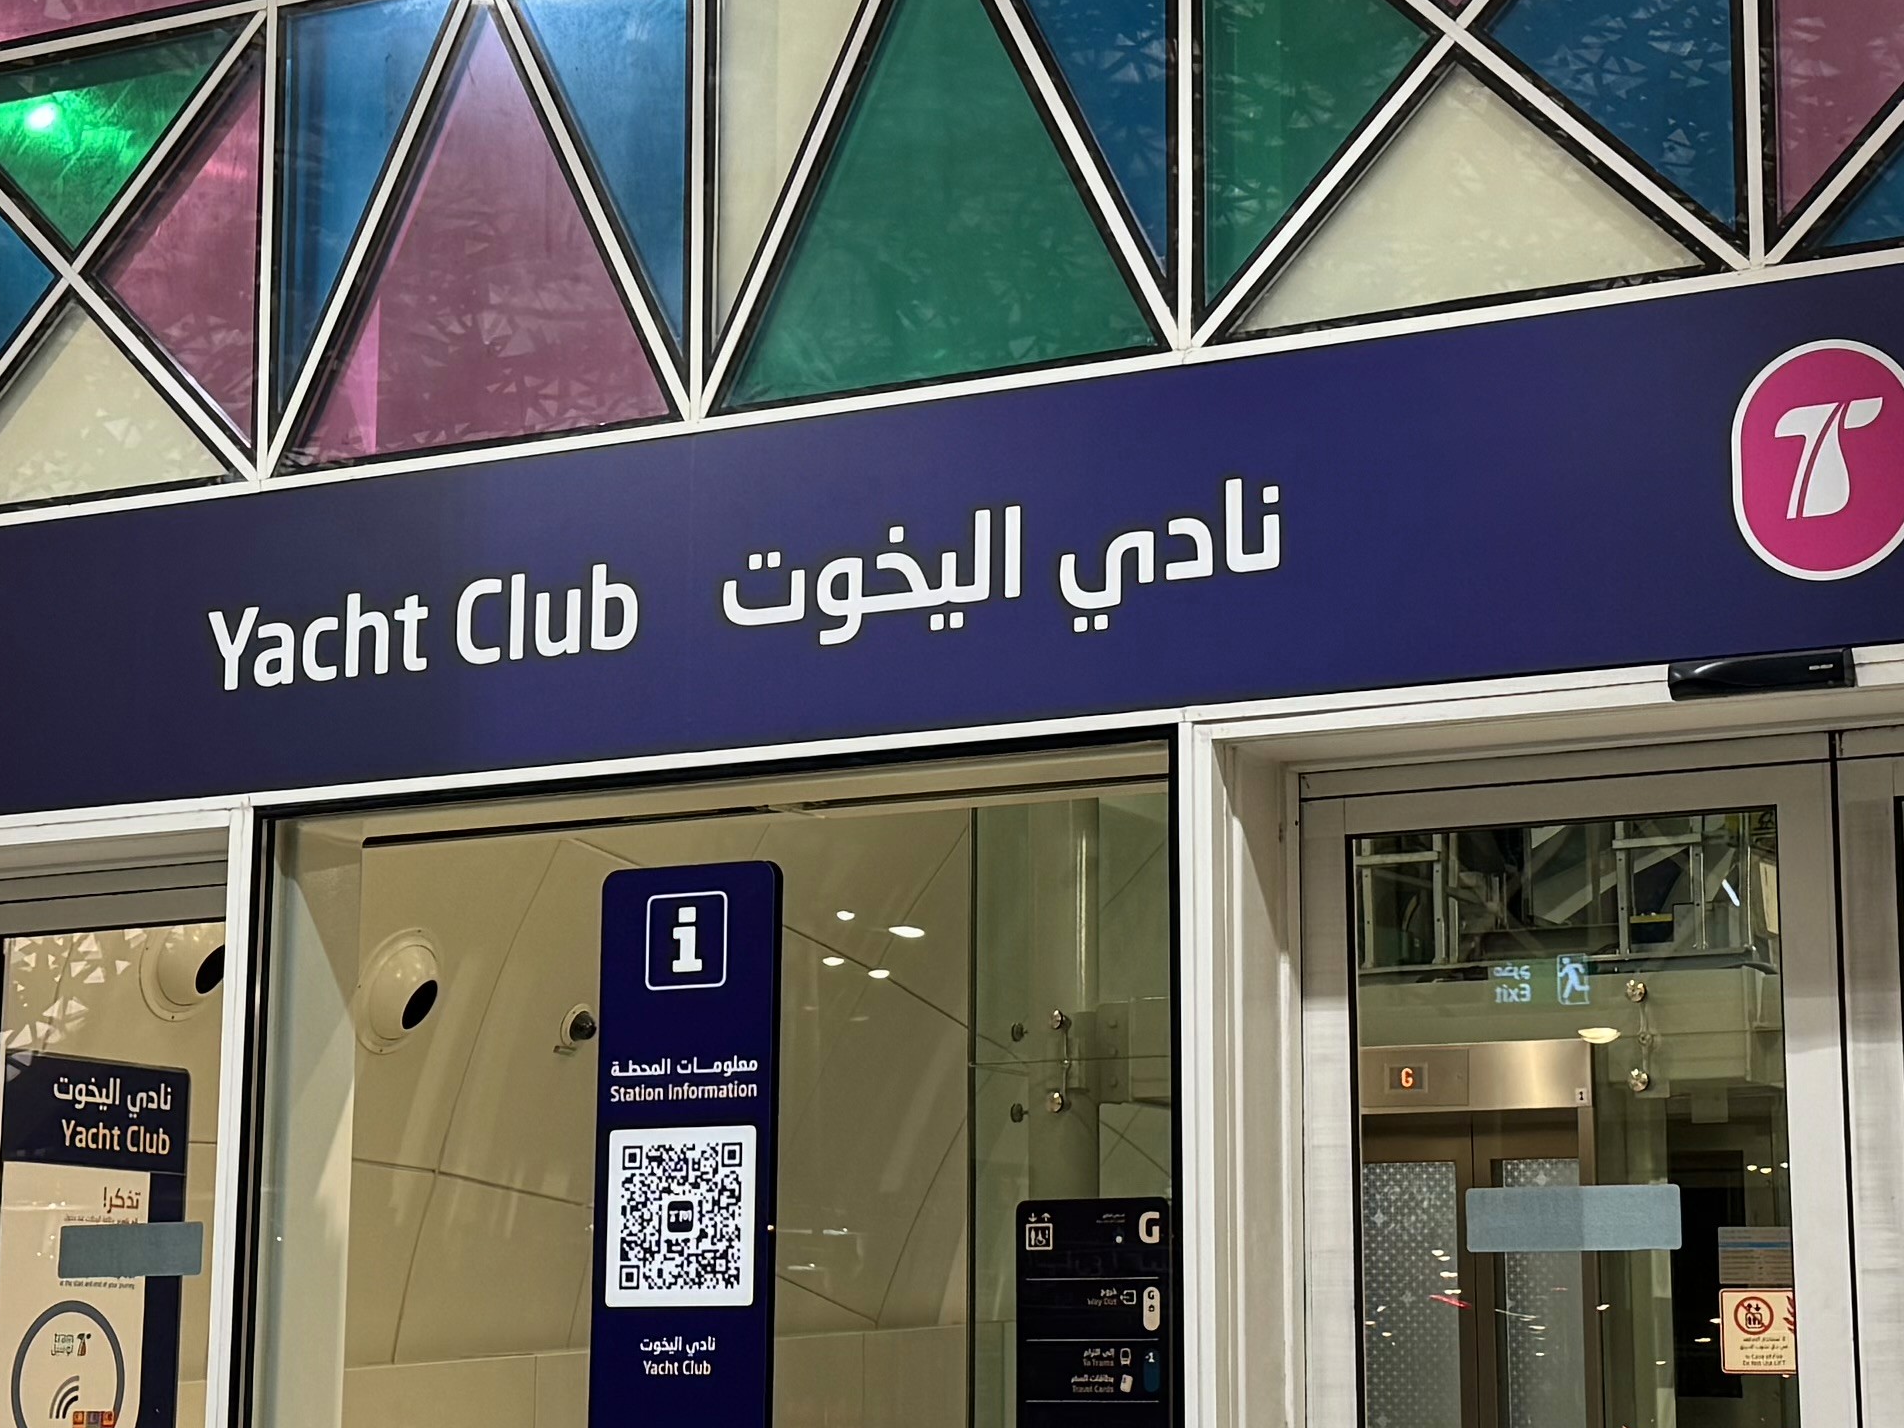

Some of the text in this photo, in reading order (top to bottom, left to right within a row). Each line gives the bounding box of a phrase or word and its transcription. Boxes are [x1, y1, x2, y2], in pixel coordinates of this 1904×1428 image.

[723, 478, 1281, 646] نادي اليخوت
[208, 563, 639, 691] Yacht Club
[53, 1077, 172, 1118] نادي اليخوت
[610, 1080, 758, 1103] Station Information
[61, 1118, 171, 1155] Yacht Club
[103, 1186, 141, 1214] تذكر!
[1138, 1211, 1160, 1243] G
[640, 1336, 716, 1357] نادي اليخوت
[642, 1360, 712, 1376] Yacht Club
